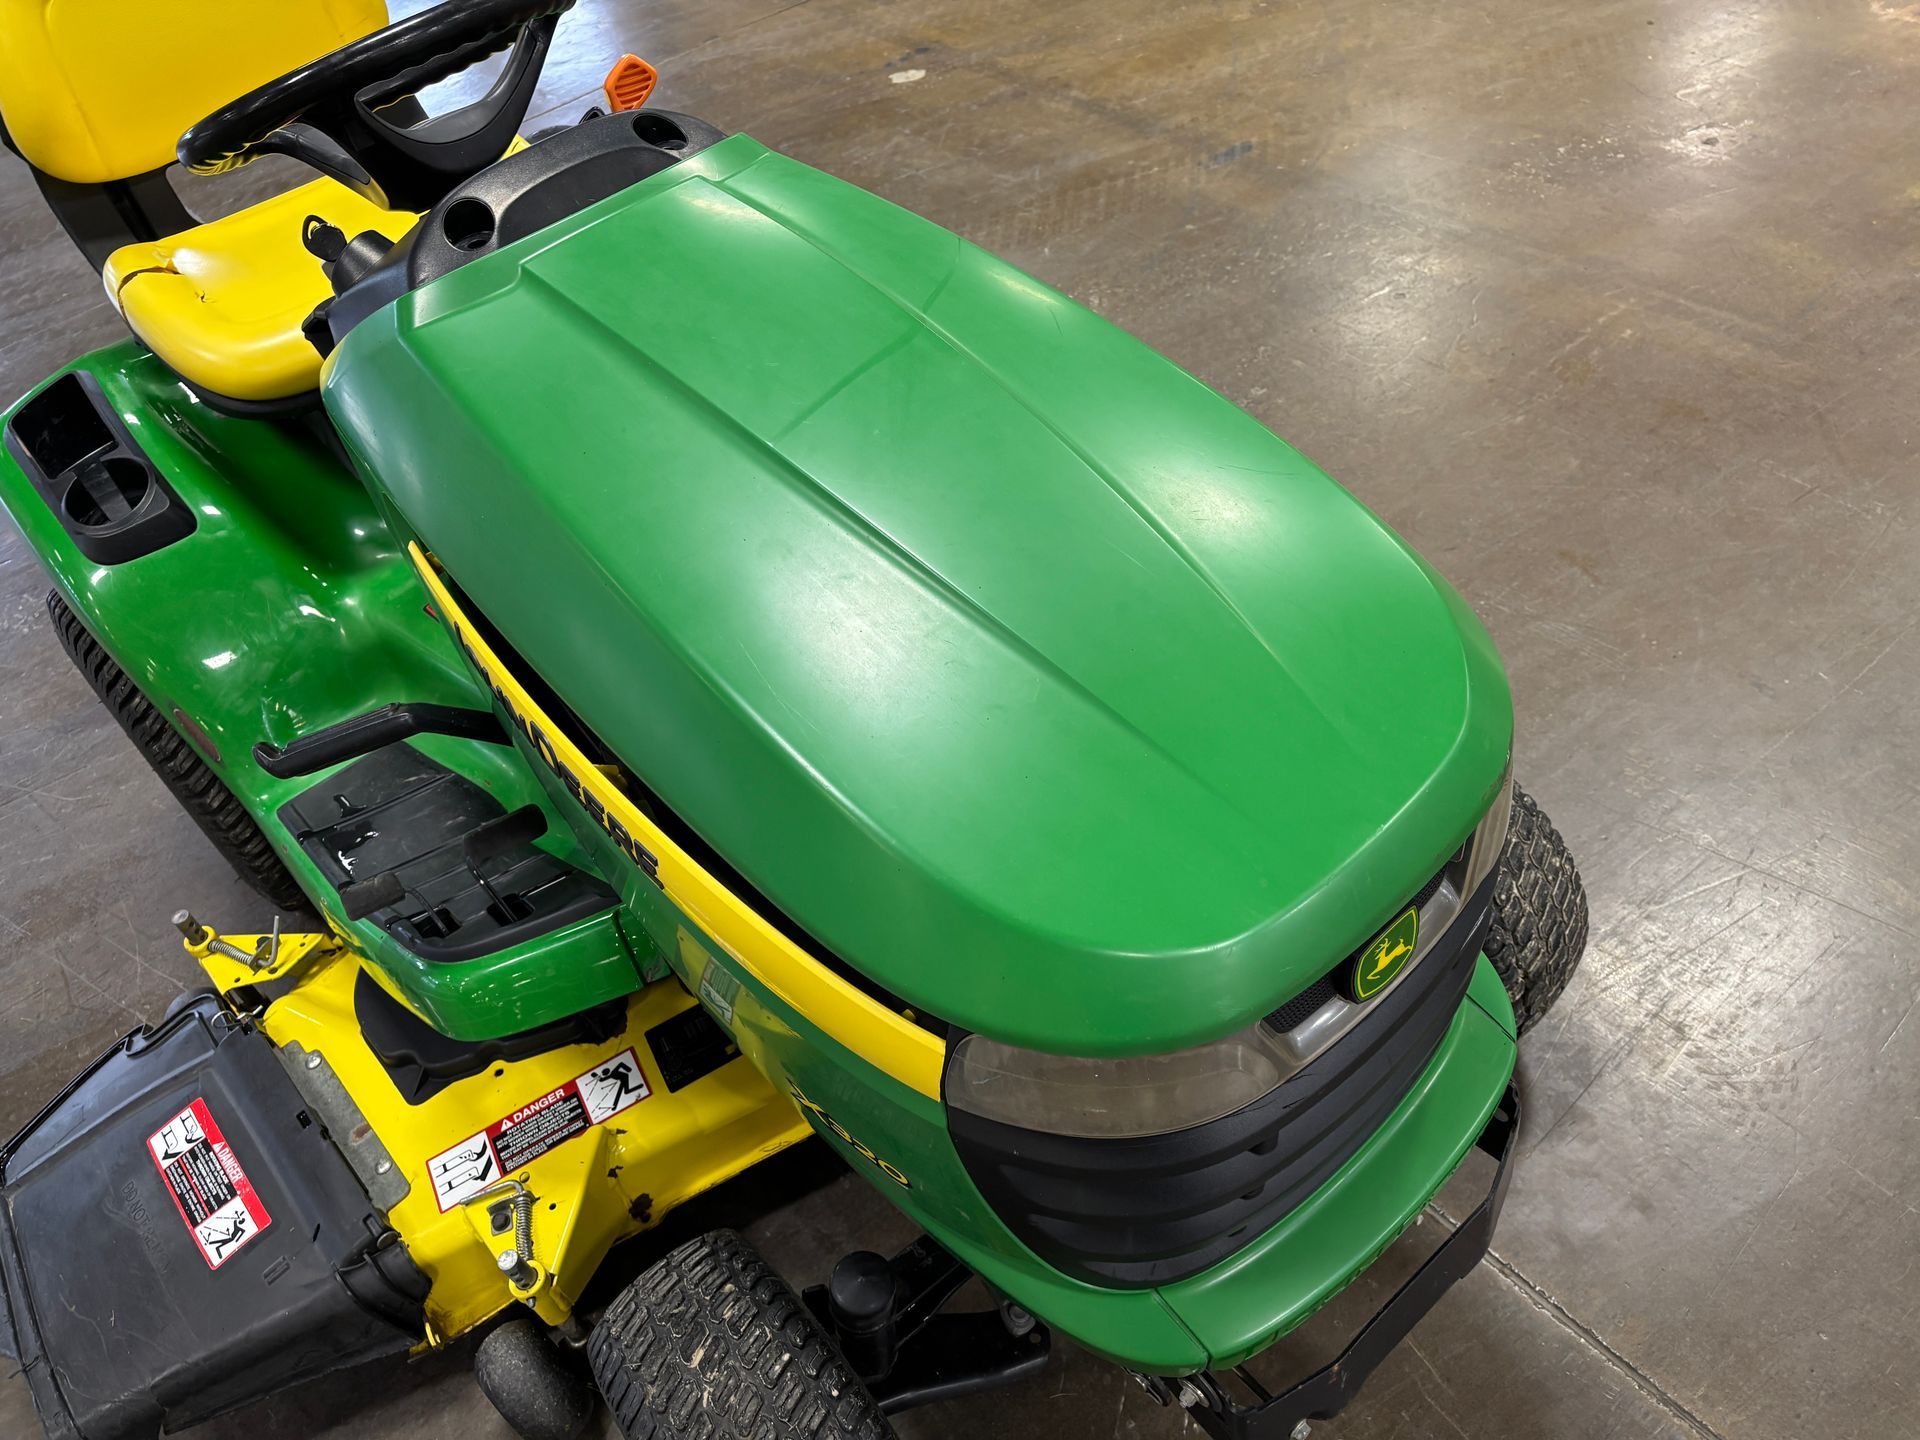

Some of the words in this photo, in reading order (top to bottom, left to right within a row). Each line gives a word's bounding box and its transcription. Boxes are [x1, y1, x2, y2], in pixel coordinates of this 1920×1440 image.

[529, 720, 665, 890] DEERE
[513, 1088, 565, 1123] DANGER
[785, 1076, 912, 1189] X320
[218, 1148, 244, 1183] DANGER
